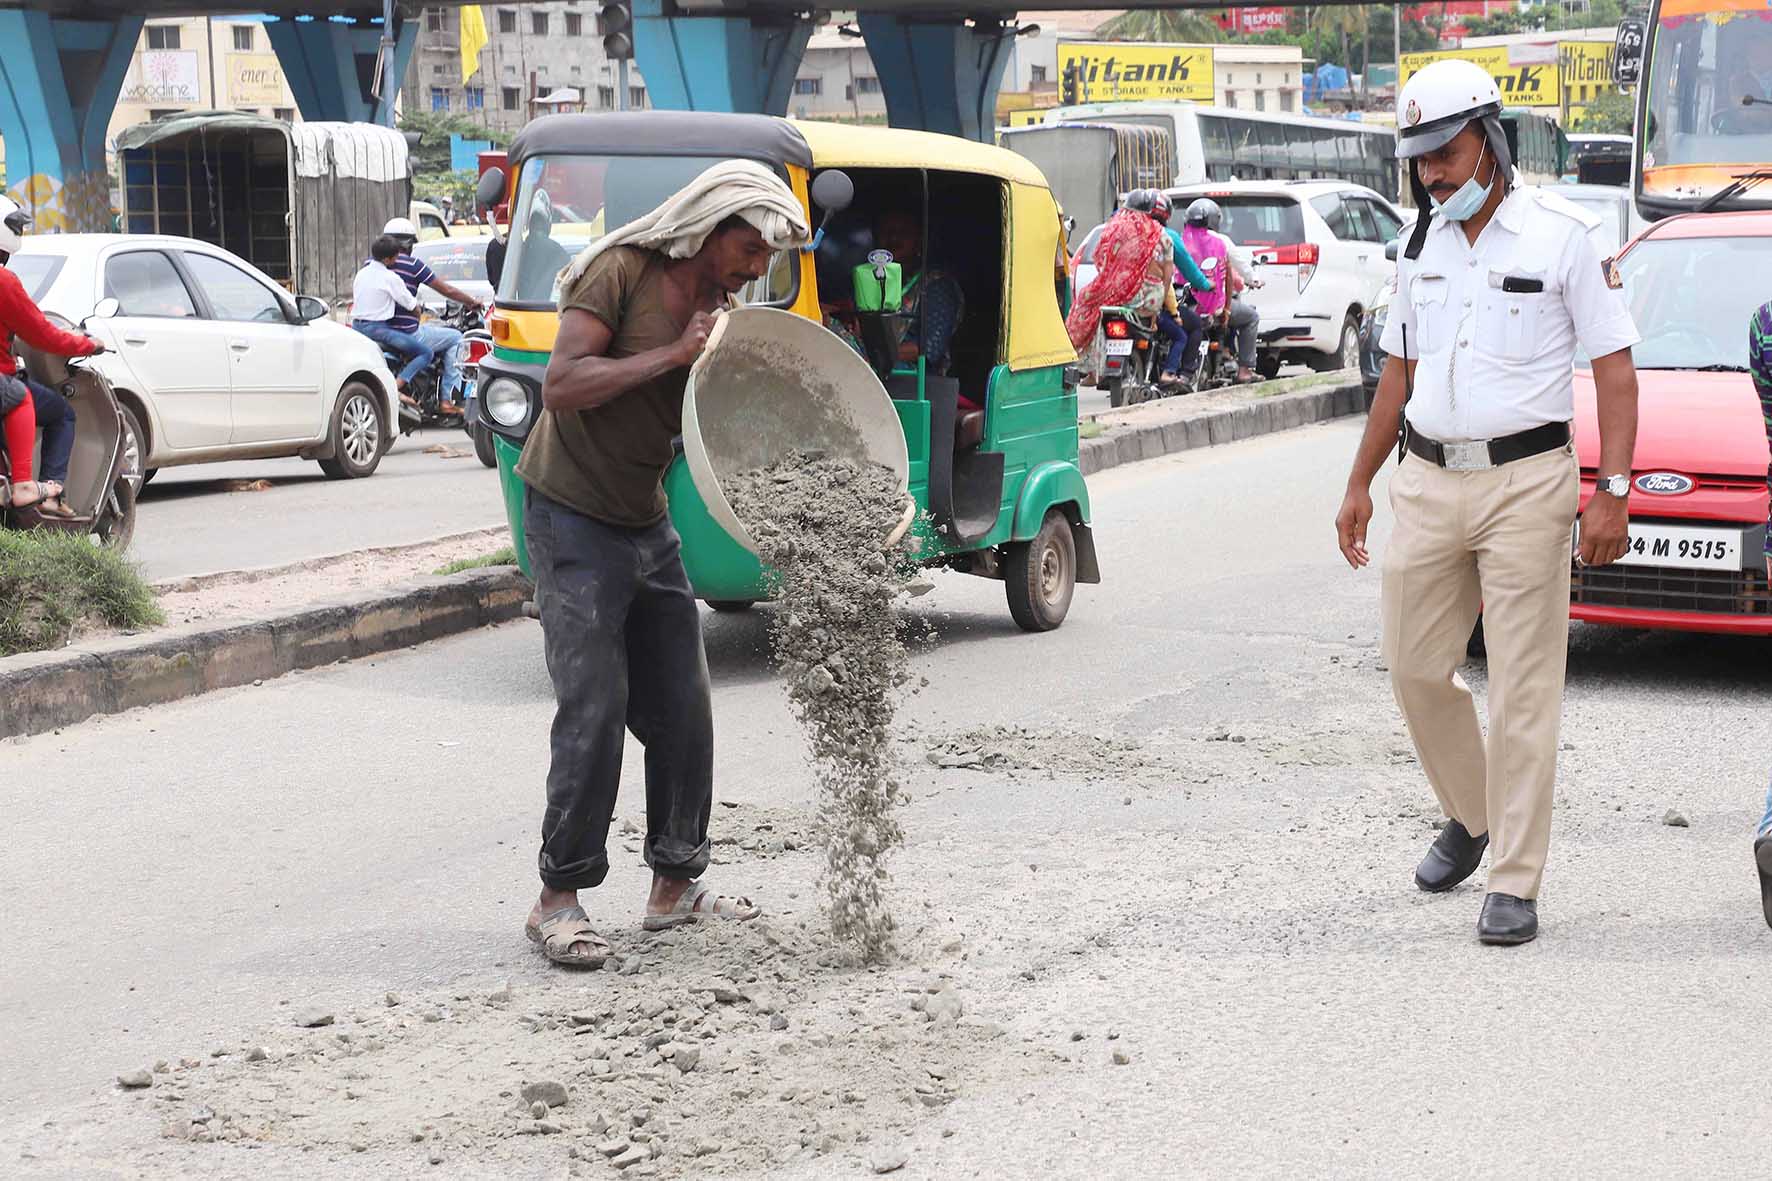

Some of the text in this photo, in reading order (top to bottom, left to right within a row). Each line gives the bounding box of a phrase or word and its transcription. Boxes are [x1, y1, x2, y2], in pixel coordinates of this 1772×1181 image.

[1066, 55, 1193, 82] Hitank
[1159, 86, 1193, 95] TANKS
[1507, 95, 1543, 103] TANKS
[1646, 475, 1680, 490] Ford
[1652, 538, 1670, 557] M
[1678, 539, 1726, 560] 9515
